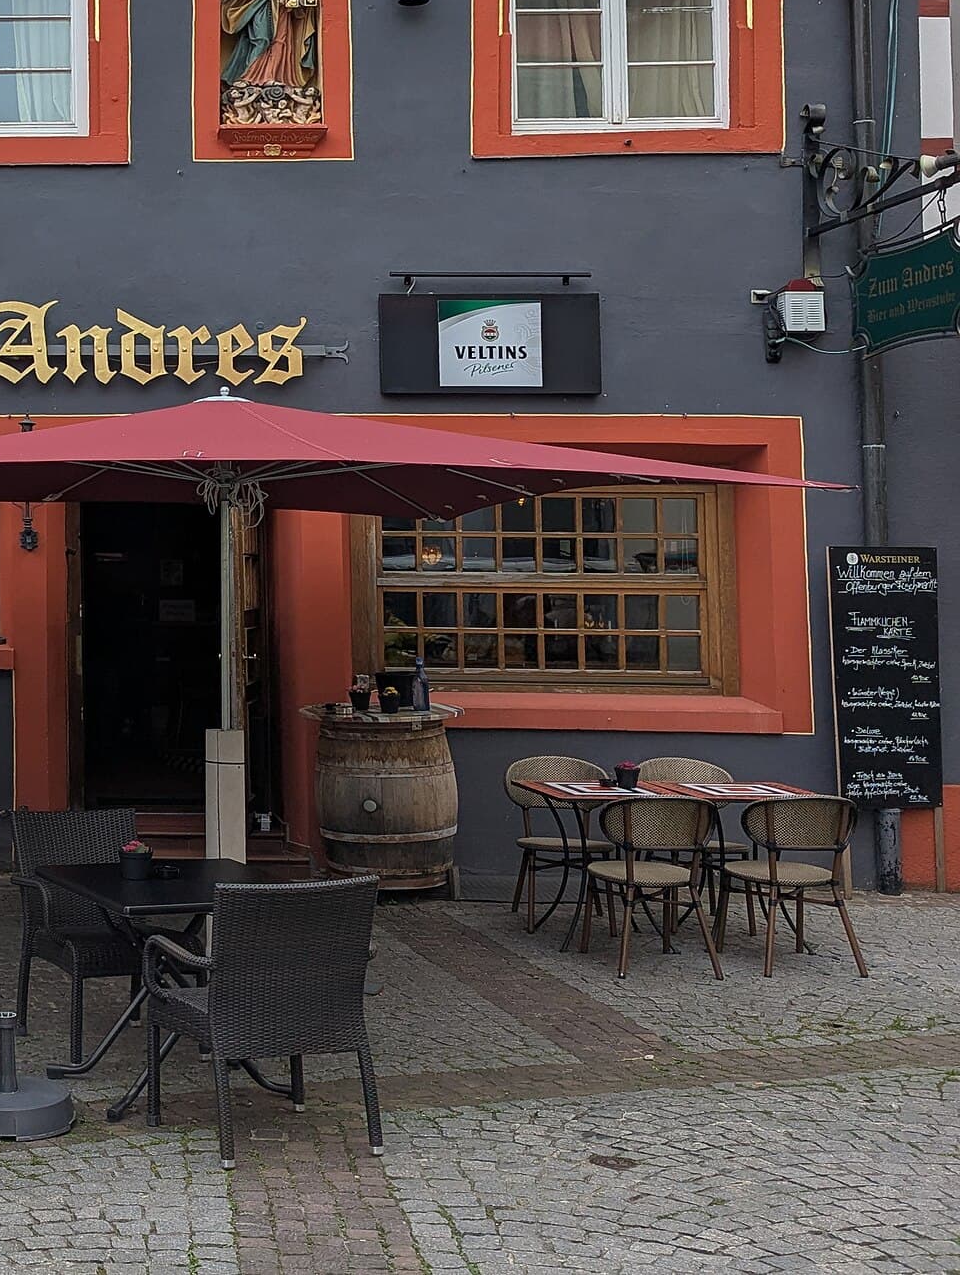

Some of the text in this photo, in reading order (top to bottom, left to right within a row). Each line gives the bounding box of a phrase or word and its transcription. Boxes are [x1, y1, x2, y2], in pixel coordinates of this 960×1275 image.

[868, 259, 955, 299] Zum Andres
[455, 345, 528, 360] VELTINS
[464, 362, 515, 377] Pilsener
[860, 554, 920, 564] WARSTEINER
